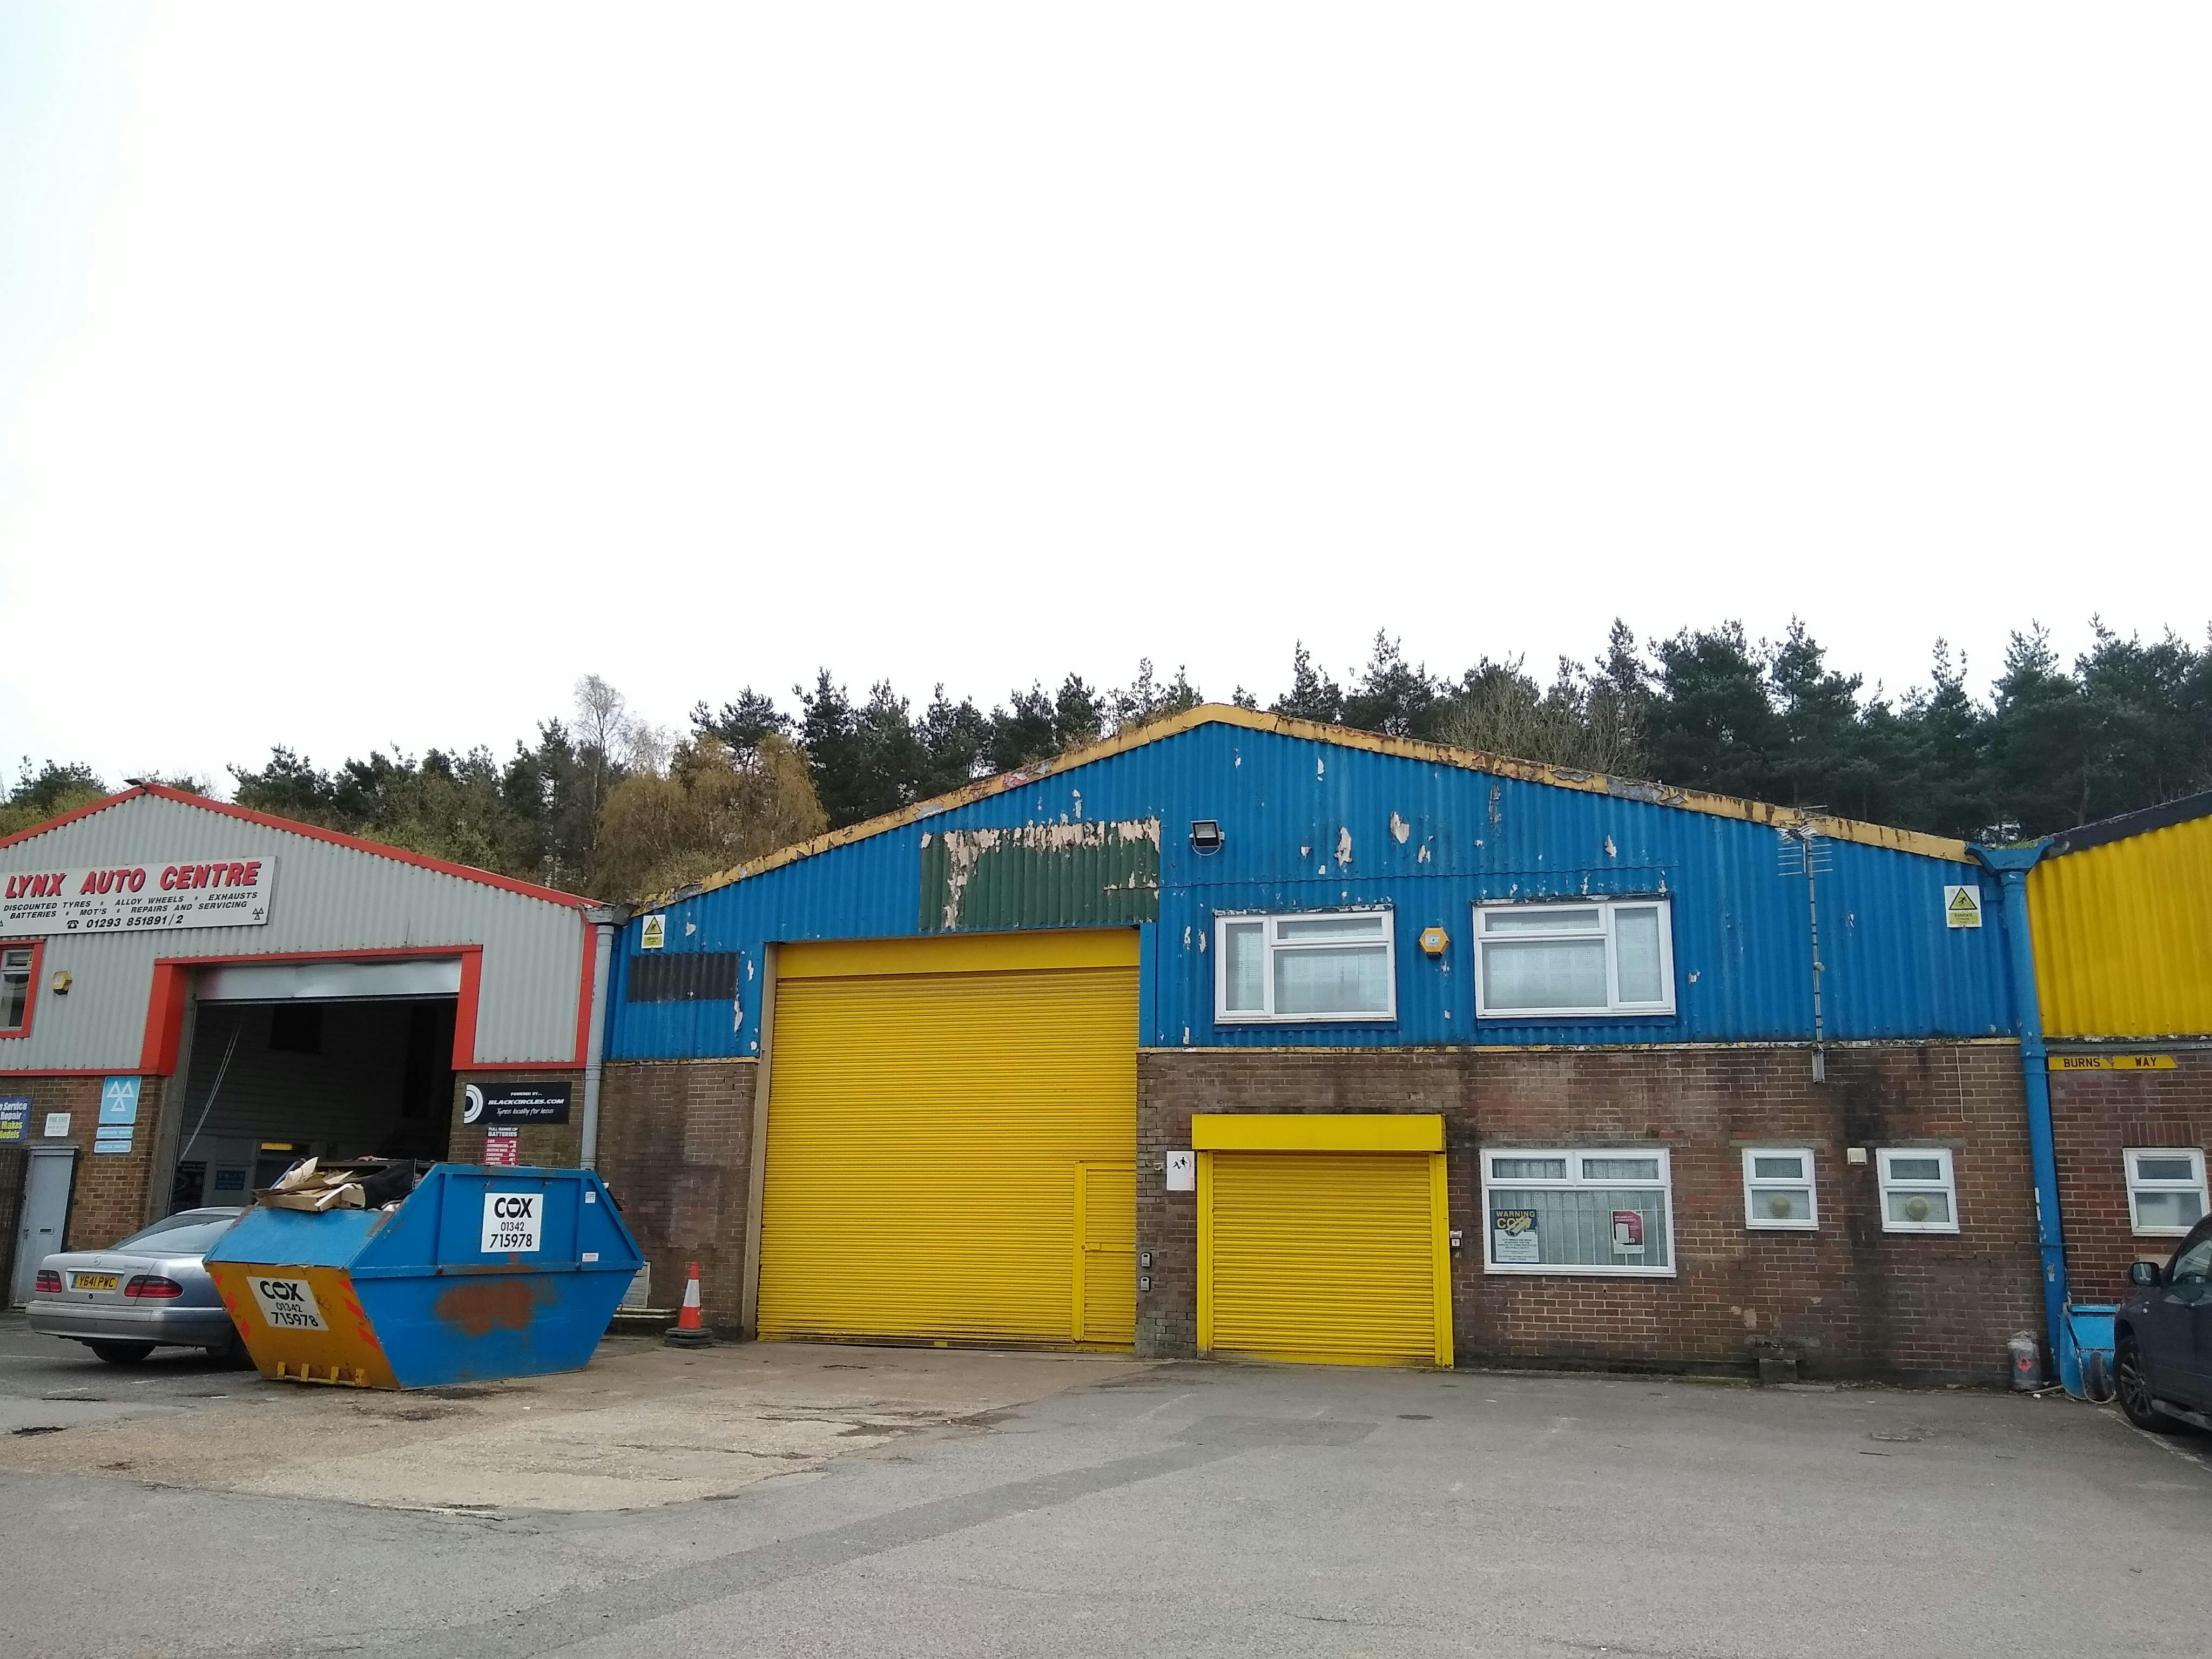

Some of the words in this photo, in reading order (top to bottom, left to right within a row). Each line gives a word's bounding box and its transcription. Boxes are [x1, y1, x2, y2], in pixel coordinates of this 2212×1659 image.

[4, 873, 67, 899] LYNX
[79, 867, 146, 895] AUTO
[160, 861, 262, 891] CENTRE
[3, 902, 57, 912] DISCOUNTED
[63, 900, 92, 908] TYRES
[149, 895, 184, 904] WHEELS
[208, 892, 258, 901] EXHAUSTS
[10, 911, 57, 919] BATTERIES
[79, 908, 107, 916] MOT'S
[130, 905, 168, 913] REPAIRS
[198, 901, 247, 910] SERVICING
[86, 918, 121, 928] 01293
[126, 914, 184, 927] 851891/2
[2063, 1057, 2100, 1068] BURNS
[2135, 1057, 2156, 1067] WAY
[3, 1102, 28, 1111] Service
[496, 1108, 512, 1117] Tyres
[512, 1108, 530, 1116] locally
[529, 1108, 540, 1116] for
[0, 1111, 22, 1121] Repair
[1, 1121, 23, 1129] Makes
[494, 1197, 534, 1218] COX
[501, 1222, 524, 1231] 01342
[489, 1233, 532, 1248] 715978
[79, 1276, 97, 1286] Y641
[260, 1280, 305, 1301] COX
[276, 1302, 303, 1312] 01342
[271, 1312, 319, 1327] 715978
